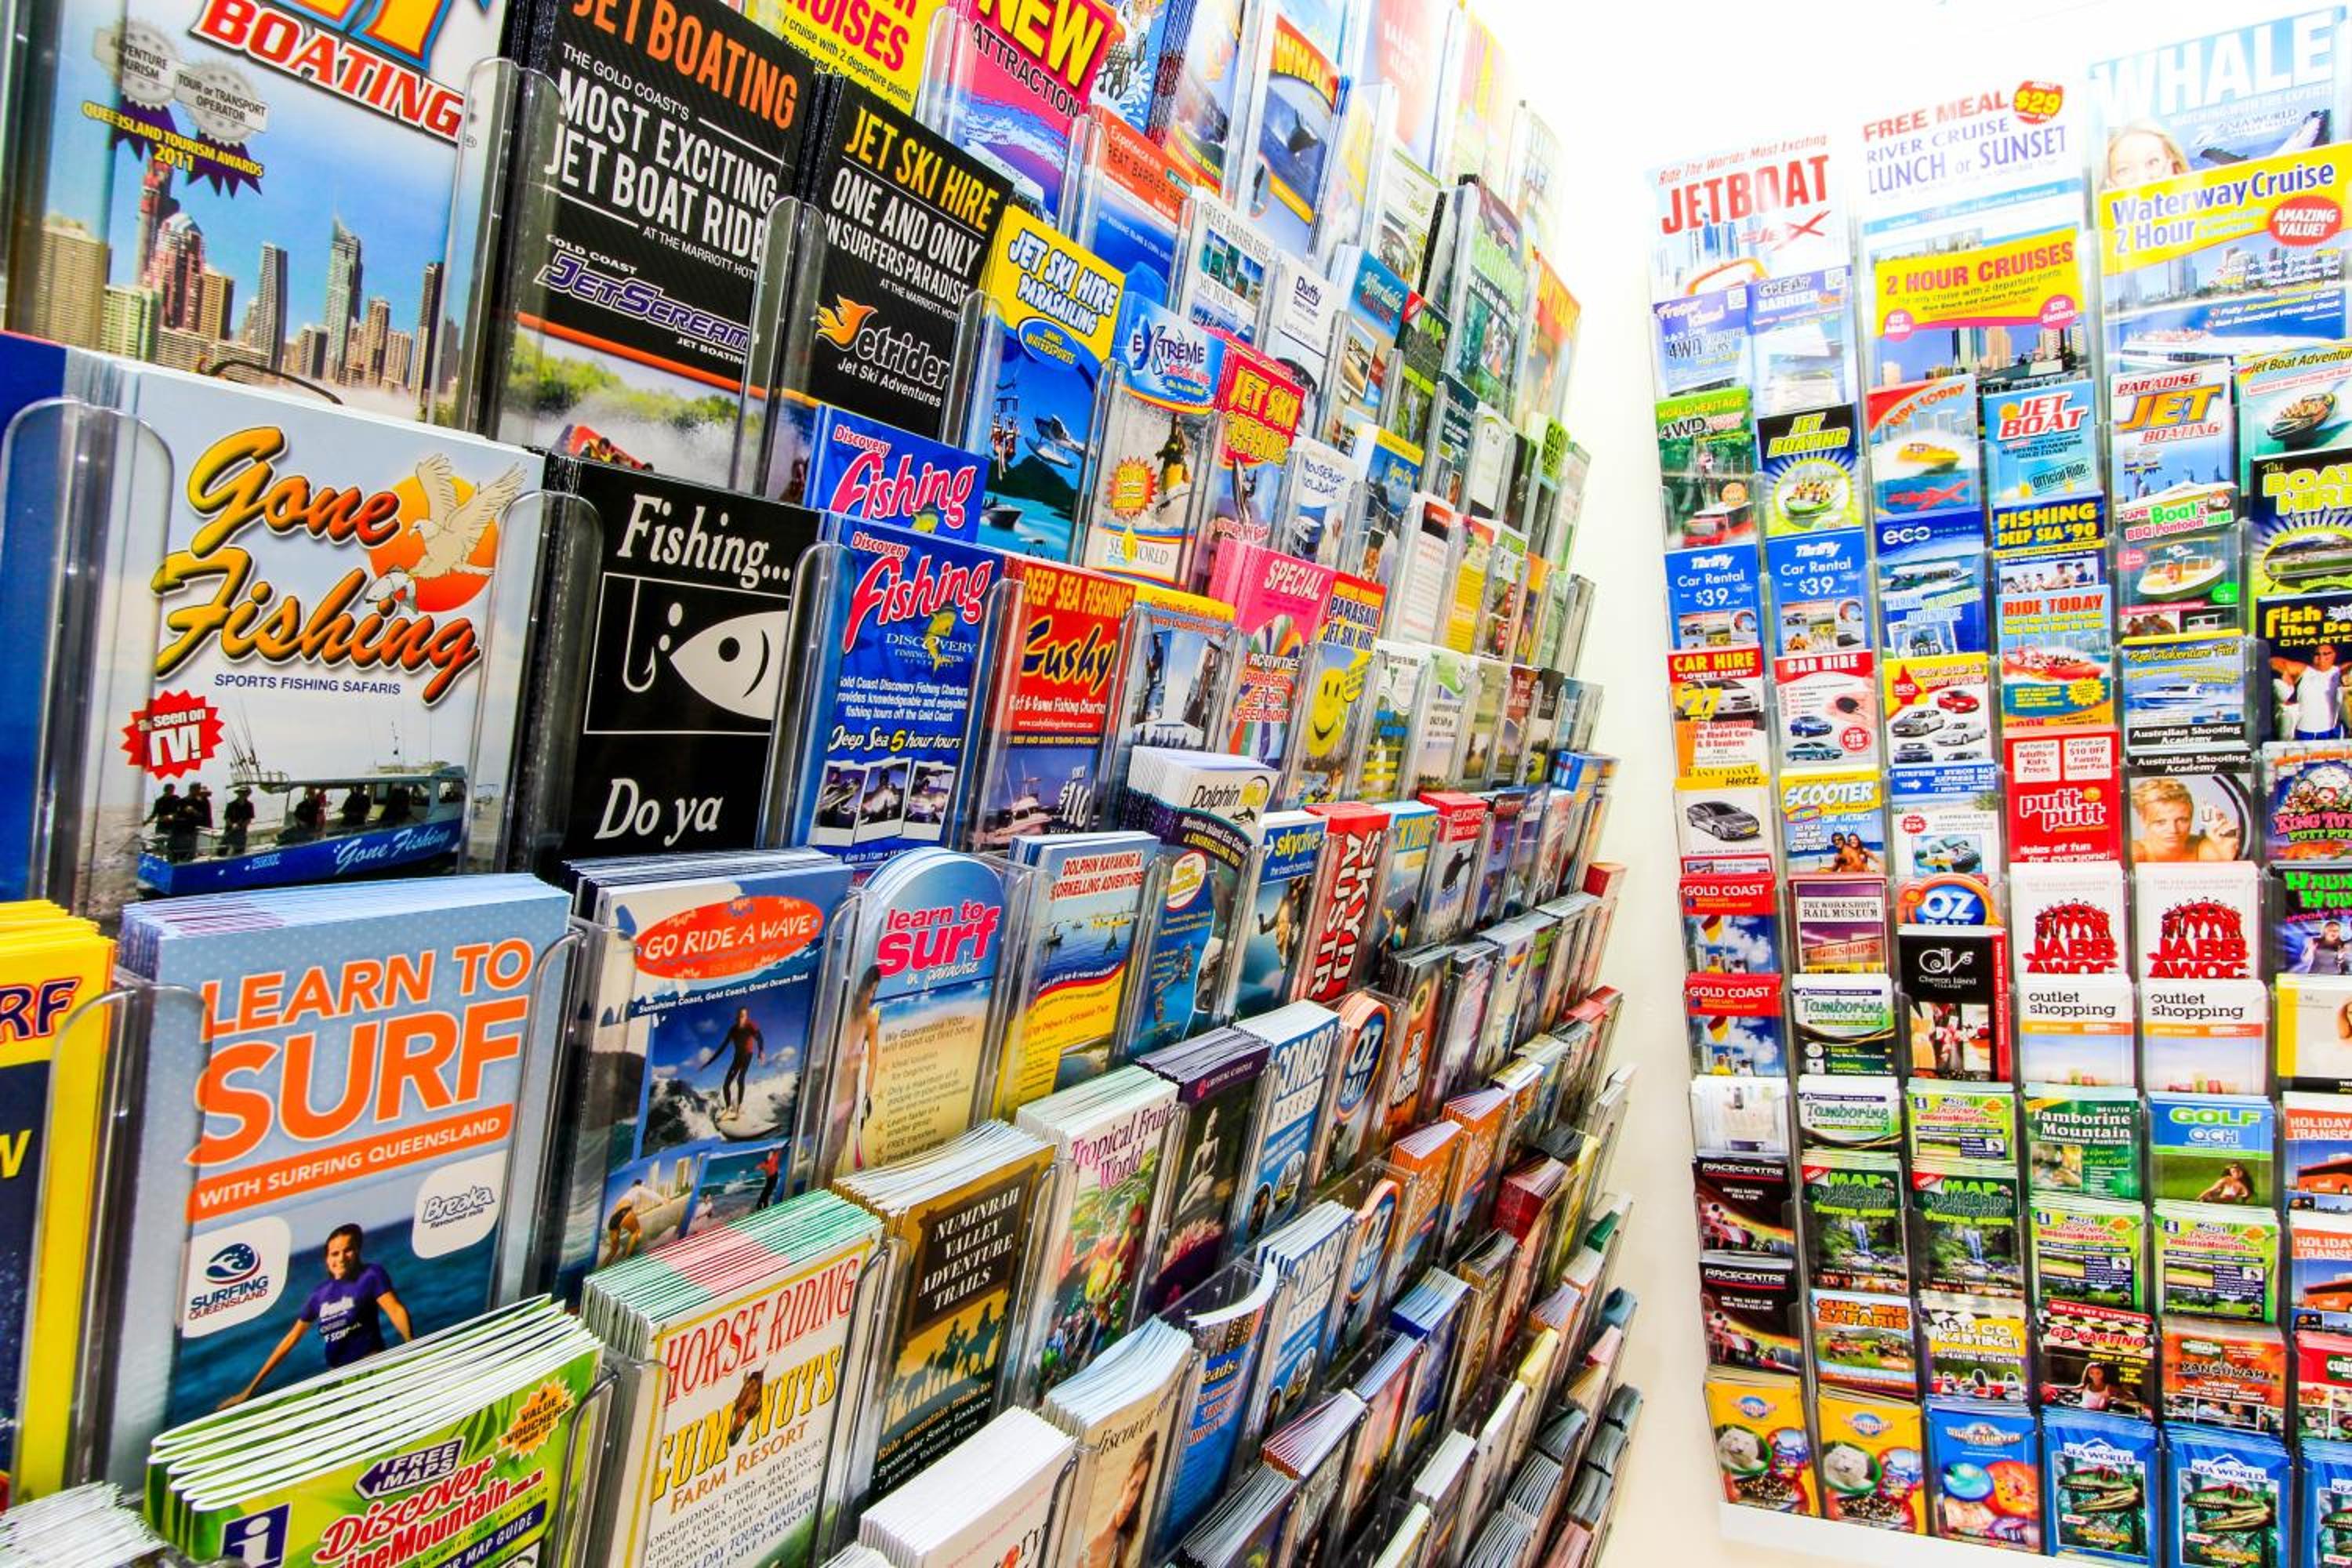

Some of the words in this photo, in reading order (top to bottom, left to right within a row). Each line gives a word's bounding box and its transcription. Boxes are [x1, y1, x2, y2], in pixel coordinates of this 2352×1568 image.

[194, 0, 465, 144] BOATING
[646, 0, 798, 131] BOATING
[975, 22, 1082, 119] ATTRACTION
[178, 74, 202, 92] TOUR
[212, 86, 267, 117] TRANSPORT
[562, 42, 590, 71] THE
[593, 60, 632, 89] GOLD
[634, 81, 690, 122] COAST'S
[195, 94, 246, 122] OPERATOR
[1862, 109, 1929, 143] FREE
[1935, 90, 2009, 125] MEAL
[164, 128, 214, 159] TOURISM
[215, 147, 263, 177] AWARDS
[557, 67, 650, 154] MOST
[655, 118, 778, 214] EXCITING
[1866, 138, 1924, 165] RIVER
[1931, 117, 2010, 148] CRUISE
[154, 143, 195, 172] 2011
[844, 105, 898, 172] JET
[896, 137, 943, 198] SKI
[939, 165, 1000, 232] HIRE
[1867, 151, 1946, 195] LUNCH
[1978, 124, 2067, 169] SUNSET
[544, 122, 608, 196] JET
[612, 151, 699, 234] BOAT
[1661, 153, 1830, 235] JETBOAT
[2111, 178, 2248, 226] Waterway
[2250, 162, 2335, 199] Cruise
[830, 167, 876, 233] ONE
[879, 197, 927, 252] AND
[927, 215, 982, 278] ONLY
[2273, 207, 2338, 224] AMAZING
[2277, 221, 2327, 237] VALUE!
[642, 225, 657, 239] AT
[658, 230, 681, 251] THE
[681, 237, 733, 270] MARRIOTT
[2114, 227, 2128, 254] 2
[2135, 219, 2196, 250] Hour
[1886, 274, 1898, 296] 2
[1905, 265, 1969, 293] HOUR
[1977, 241, 2074, 283] CRUISES
[1017, 275, 1098, 336] PARASAILING
[677, 336, 701, 350] JET
[837, 358, 858, 374] Jet
[858, 366, 879, 383] Ski
[880, 376, 942, 408] Adventures
[2117, 372, 2201, 394] PARADISE
[2017, 391, 2072, 419] JET
[2115, 383, 2226, 432] JET
[1998, 406, 2089, 441] BOAT
[2141, 420, 2221, 445] BOATING
[833, 425, 891, 457] Discovery
[187, 425, 401, 560] Gone
[829, 450, 977, 530] Fishing
[1998, 502, 2097, 531] FISHING
[2149, 500, 2197, 525] Boat
[1998, 528, 2033, 546] DEEP
[2035, 525, 2063, 541] SEA
[1264, 559, 1325, 602] SPECIAL
[1677, 575, 1702, 588] Car
[1704, 568, 1744, 585] Rental
[1780, 564, 1806, 576] Car
[1809, 556, 1852, 572] Rental
[1055, 572, 1083, 614] SEA
[1798, 576, 1835, 596] $39
[842, 554, 994, 655] Fishing
[2003, 598, 2042, 617] RIDE
[2047, 593, 2104, 613] TODAY
[151, 546, 482, 706] Fishing
[2265, 605, 2322, 640] Fish
[1673, 654, 1708, 673] CAR
[1713, 652, 1755, 670] HIRE
[1787, 657, 1817, 673] CAR
[1822, 654, 1860, 670] HIRE
[214, 673, 277, 689] SPORTS
[280, 677, 339, 692] FISHING
[342, 681, 401, 695] SAFARIS
[152, 710, 187, 728] seen
[188, 707, 206, 723] on
[2132, 727, 2189, 739] Australian
[2190, 724, 2241, 736] Shooting
[2136, 755, 2194, 767] Australian
[2194, 753, 2248, 764] Shooting
[2165, 763, 2217, 775] Academy
[1725, 775, 1760, 787] Hertz
[1784, 781, 1875, 808] SCOOTER
[593, 778, 661, 840] Do
[663, 793, 724, 848] ya
[2020, 787, 2084, 818] putt
[2042, 802, 2108, 834] putt
[334, 837, 389, 873] Gone
[1683, 885, 1719, 897] GOLD
[1722, 884, 1765, 897] COAST
[1922, 891, 1978, 920] OZ
[885, 906, 954, 932] learn
[960, 898, 983, 924] to
[1803, 909, 1831, 919] RAIL
[1831, 909, 1878, 918] MUSEUM
[644, 933, 679, 960] GO
[681, 927, 735, 956] RIDE
[737, 928, 756, 946] A
[760, 914, 812, 942] WAVE
[877, 906, 1001, 978] surf
[199, 949, 436, 1044] LEARN
[452, 937, 534, 996] TO
[638, 997, 676, 1014] Sunshine
[705, 989, 723, 1002] Gold
[768, 976, 790, 989] Ocean
[1689, 986, 1726, 998] GOLD
[1728, 986, 1770, 998] COAST
[1802, 997, 1886, 1015] Tamborine
[2028, 991, 2080, 1004] outlet
[2151, 993, 2205, 1005] outlet
[2029, 1004, 2116, 1018] shopping
[2151, 1004, 2245, 1020] shopping
[1348, 1022, 1385, 1071] OZ
[184, 995, 531, 1167] SURF
[1806, 1102, 1889, 1120] Tamborine
[2033, 1108, 2132, 1125] Tamborine
[2169, 1106, 2263, 1127] GOLF
[2289, 1117, 2352, 1129] HOLIDAY
[1071, 1111, 1138, 1167] Tropical
[2040, 1122, 2132, 1138] Mountain
[198, 1178, 261, 1209] WITH
[267, 1150, 363, 1192] SURFING
[367, 1116, 501, 1165] QUEENSLAND
[1098, 1145, 1144, 1189] World
[1702, 1162, 1785, 1177] RACECENTRE
[1828, 1172, 1882, 1188] MAP
[1941, 1179, 2001, 1193] MAP
[935, 1185, 1019, 1243] NUMINBAH
[944, 1215, 1004, 1261] VALLEY
[918, 1234, 1015, 1298] ADVENTURE
[1704, 1268, 1786, 1283] RACECENTRE
[188, 1288, 268, 1320] QUEENSLAND
[191, 1275, 268, 1311] SURFING
[933, 1268, 992, 1312] TRAILS
[663, 1301, 767, 1408] HORSE
[766, 1257, 860, 1356] RIDING
[1817, 1310, 1910, 1330] SAFARIS
[506, 1400, 570, 1443] VOUCHERS
[394, 1446, 456, 1470] FREE
[670, 1466, 728, 1516] FARM
[735, 1420, 809, 1477] RESORT
[2064, 1447, 2087, 1459] SEA
[2089, 1450, 2135, 1465] WORLD
[383, 1458, 455, 1490] MAPS
[2192, 1464, 2216, 1475] SEA
[2217, 1467, 2267, 1482] WORLD
[312, 1455, 495, 1563] Discover
